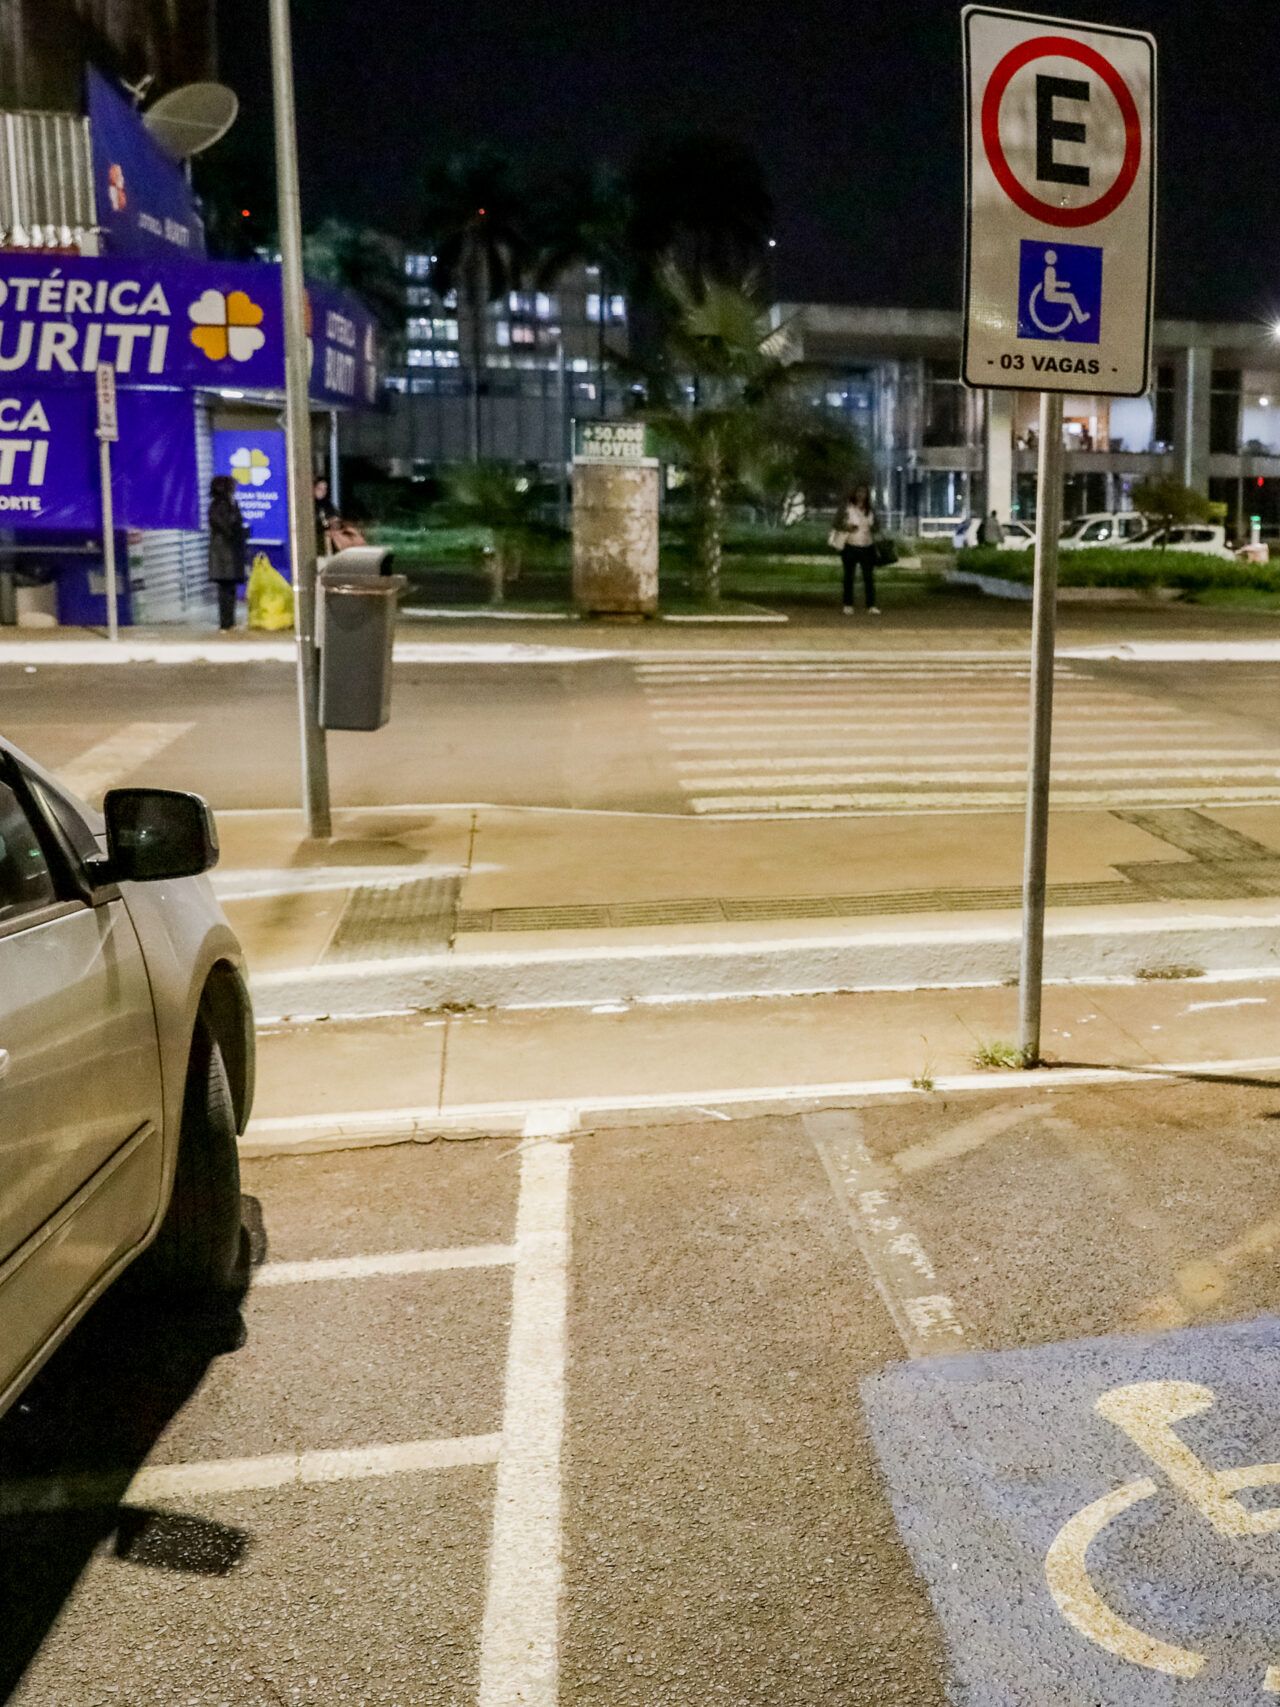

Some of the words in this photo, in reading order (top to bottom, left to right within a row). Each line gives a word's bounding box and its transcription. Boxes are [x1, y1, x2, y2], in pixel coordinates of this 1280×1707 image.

[1036, 74, 1090, 187] E
[0, 268, 171, 316] TÉRICA
[1000, 353, 1025, 371] 03
[1031, 355, 1100, 375] VAGAS
